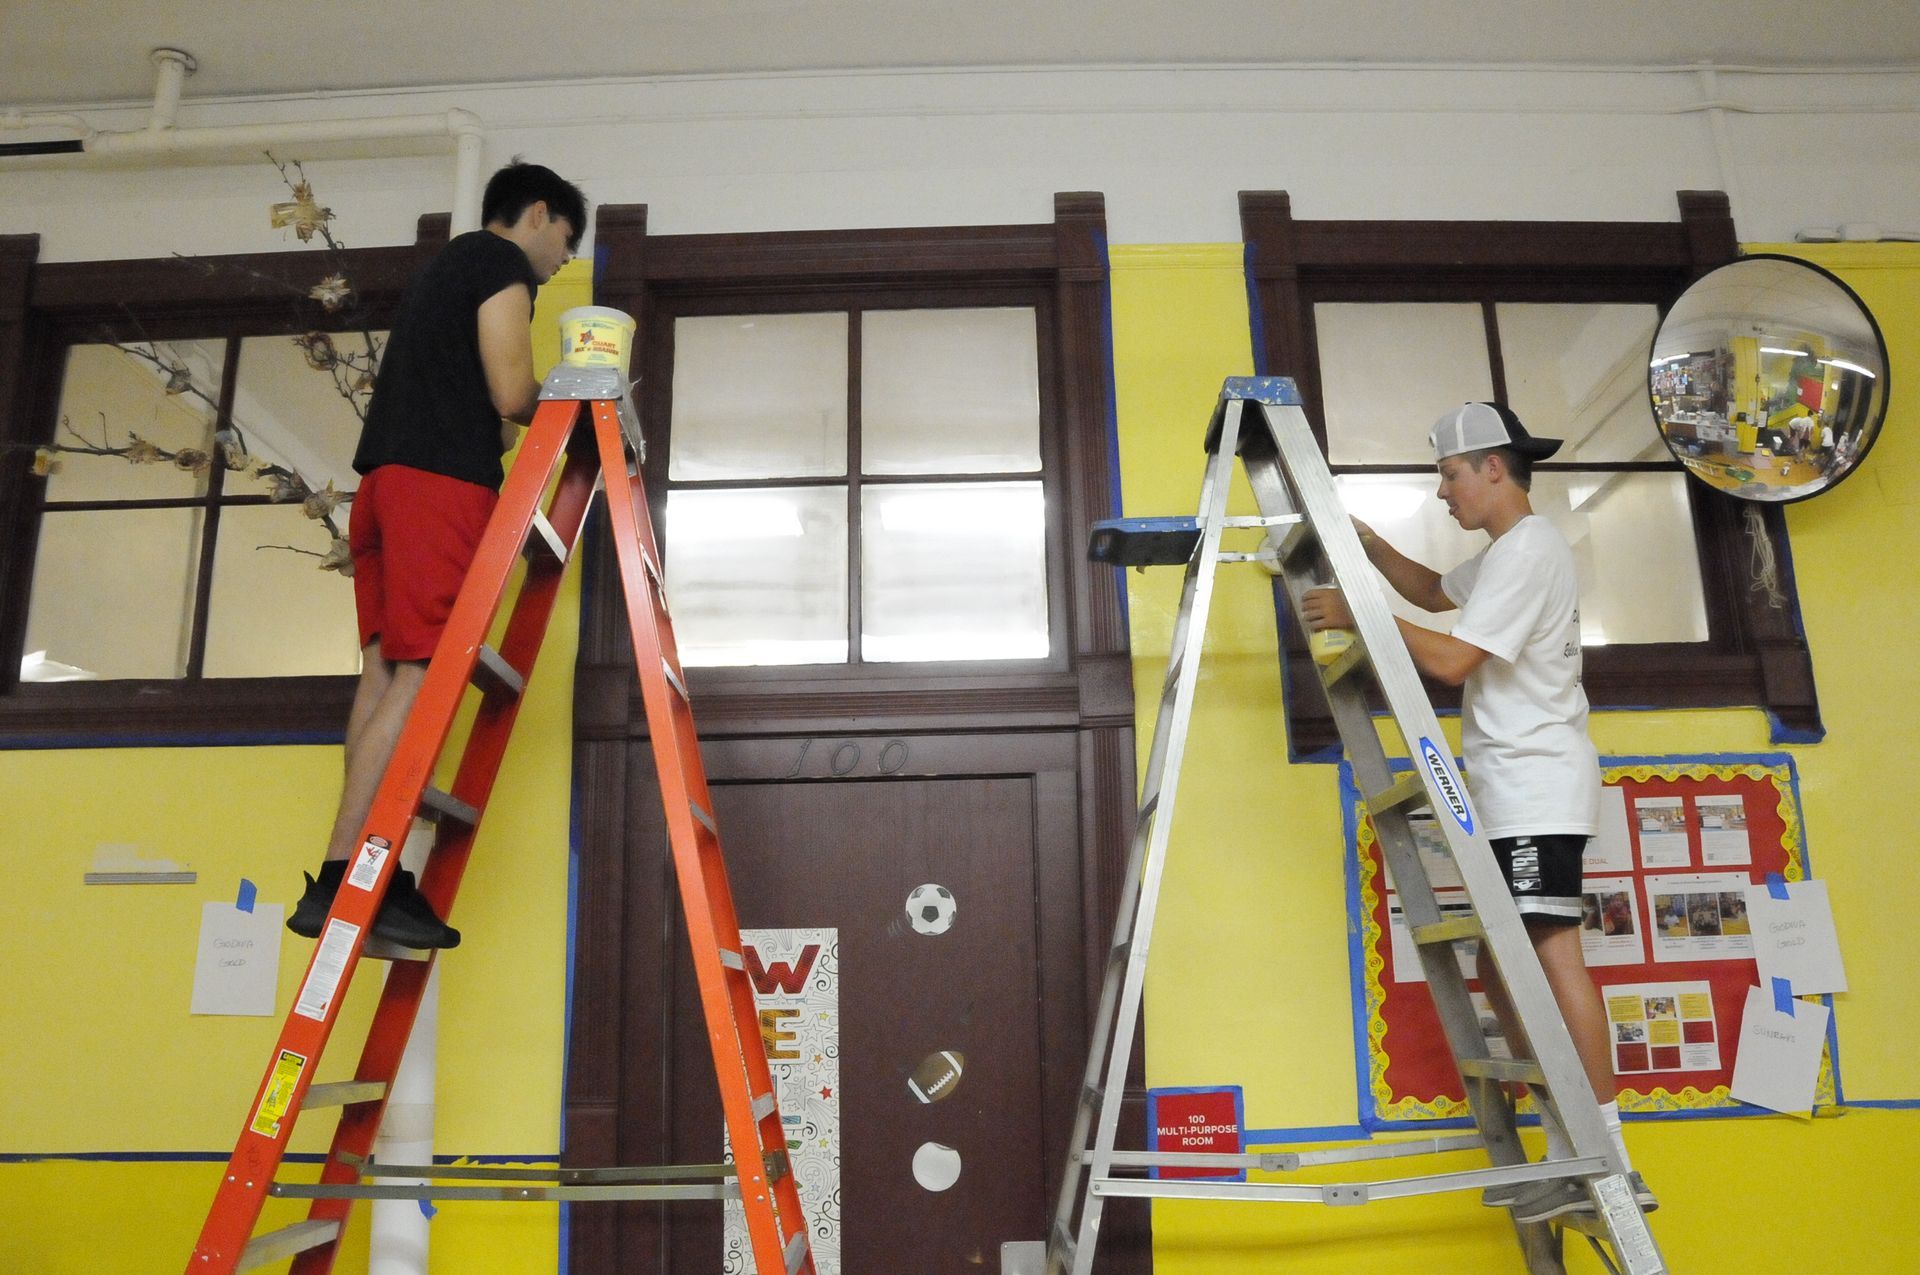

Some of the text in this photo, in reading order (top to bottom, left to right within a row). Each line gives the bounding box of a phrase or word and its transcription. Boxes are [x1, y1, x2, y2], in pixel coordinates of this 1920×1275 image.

[592, 341, 615, 349] QUART
[786, 736, 909, 777] 100
[1427, 752, 1465, 815] WERNER
[1511, 846, 1539, 878] NBA
[1188, 1115, 1205, 1124] 100
[1157, 1125, 1238, 1136] MULTI-PURPOSE
[1182, 1137, 1213, 1146] ROOM
